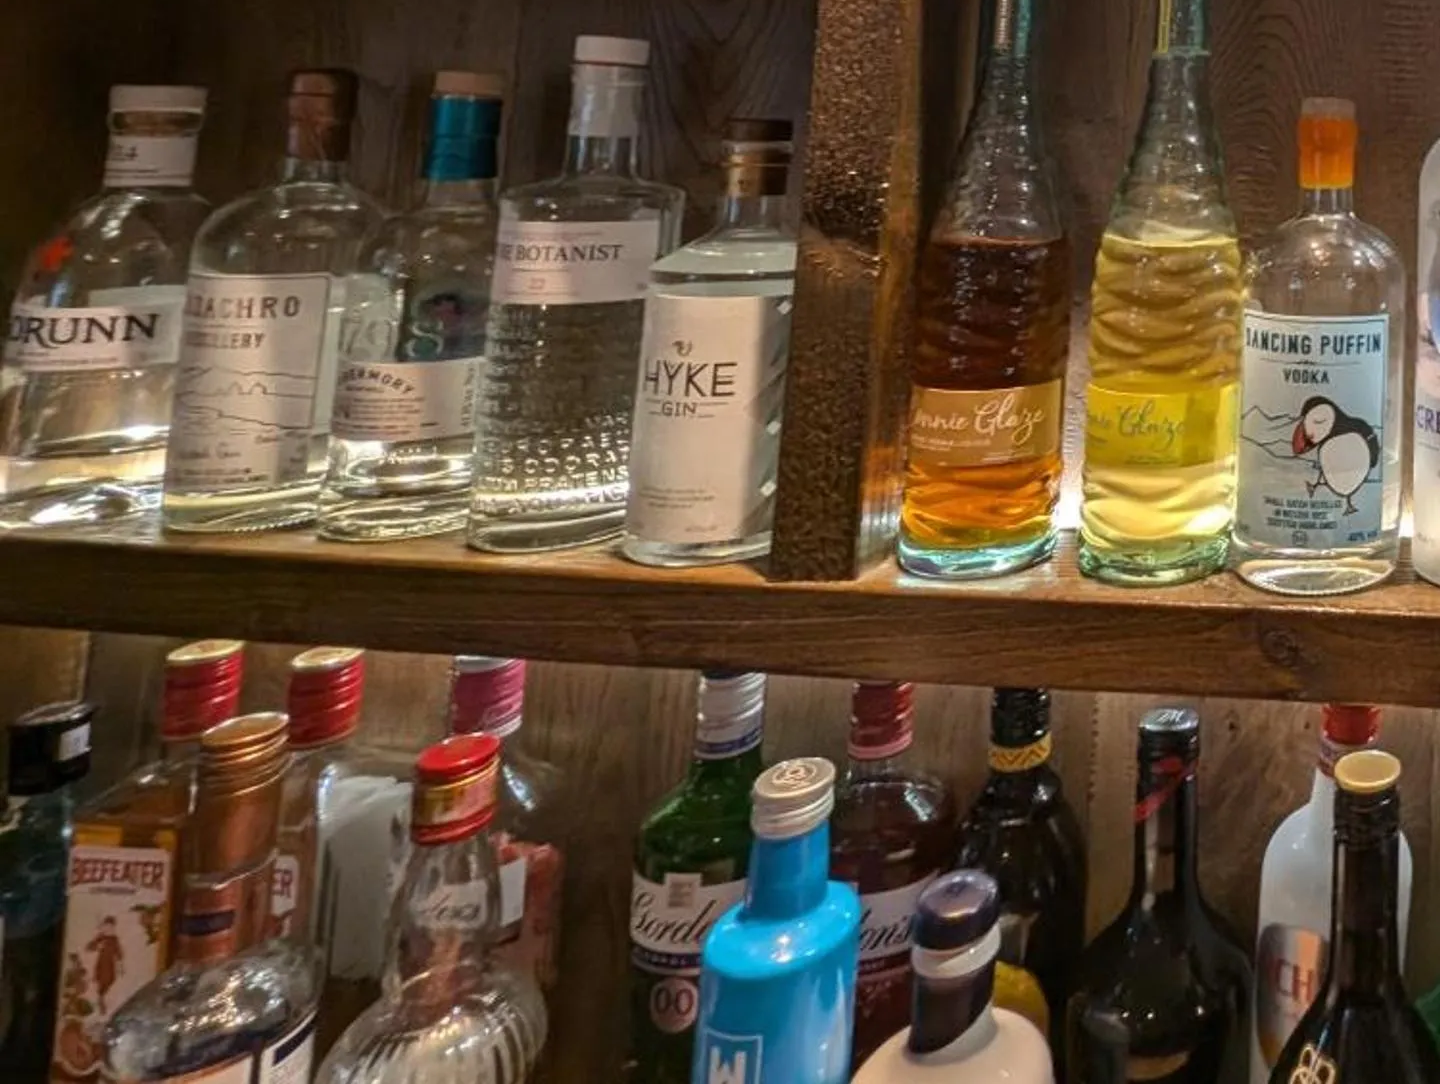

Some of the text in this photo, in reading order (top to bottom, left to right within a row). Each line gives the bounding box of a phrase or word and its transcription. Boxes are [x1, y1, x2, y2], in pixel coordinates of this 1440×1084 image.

[515, 243, 625, 262] BOTANIST
[1246, 327, 1382, 356] DANCING PUFFIN
[644, 360, 738, 398] HYKE
[1282, 369, 1330, 385] VODKA
[661, 400, 698, 417] GIN
[71, 857, 165, 891] BEEFEATER
